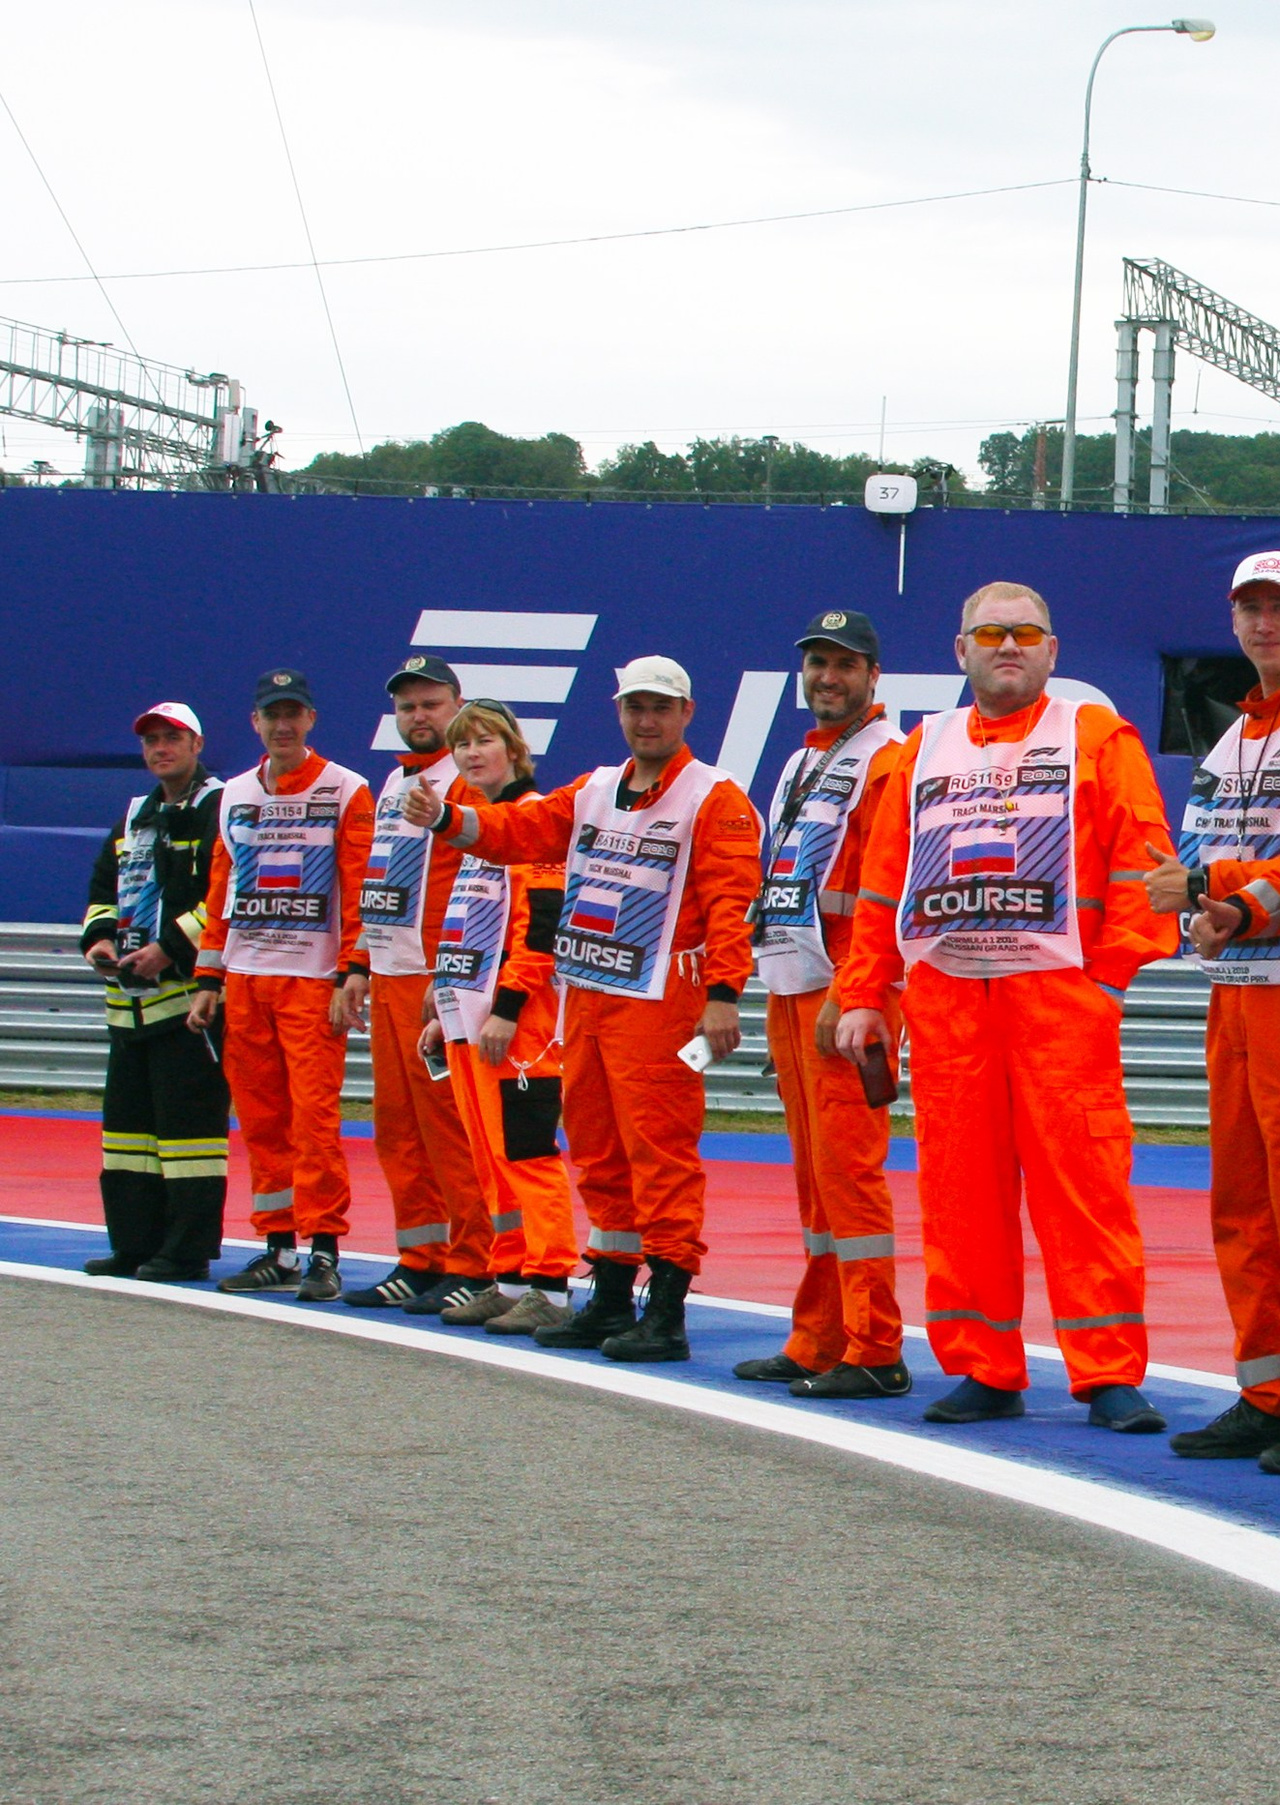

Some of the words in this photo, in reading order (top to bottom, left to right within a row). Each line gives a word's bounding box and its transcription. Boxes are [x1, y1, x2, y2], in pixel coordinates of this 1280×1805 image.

[880, 487, 899, 500] 37
[950, 772, 1013, 790] RUS1159
[1021, 769, 1067, 781] 2018
[952, 803, 978, 818] TRACK
[640, 842, 677, 857] 2018
[359, 889, 400, 912] URSE
[762, 886, 801, 910] URSE
[924, 886, 1044, 917] COURSE
[233, 897, 320, 917] COURSE
[984, 944, 1018, 952] GRAND
[1019, 944, 1040, 952] PRIX
[995, 936, 1018, 944] 2018
[435, 952, 475, 974] URSE
